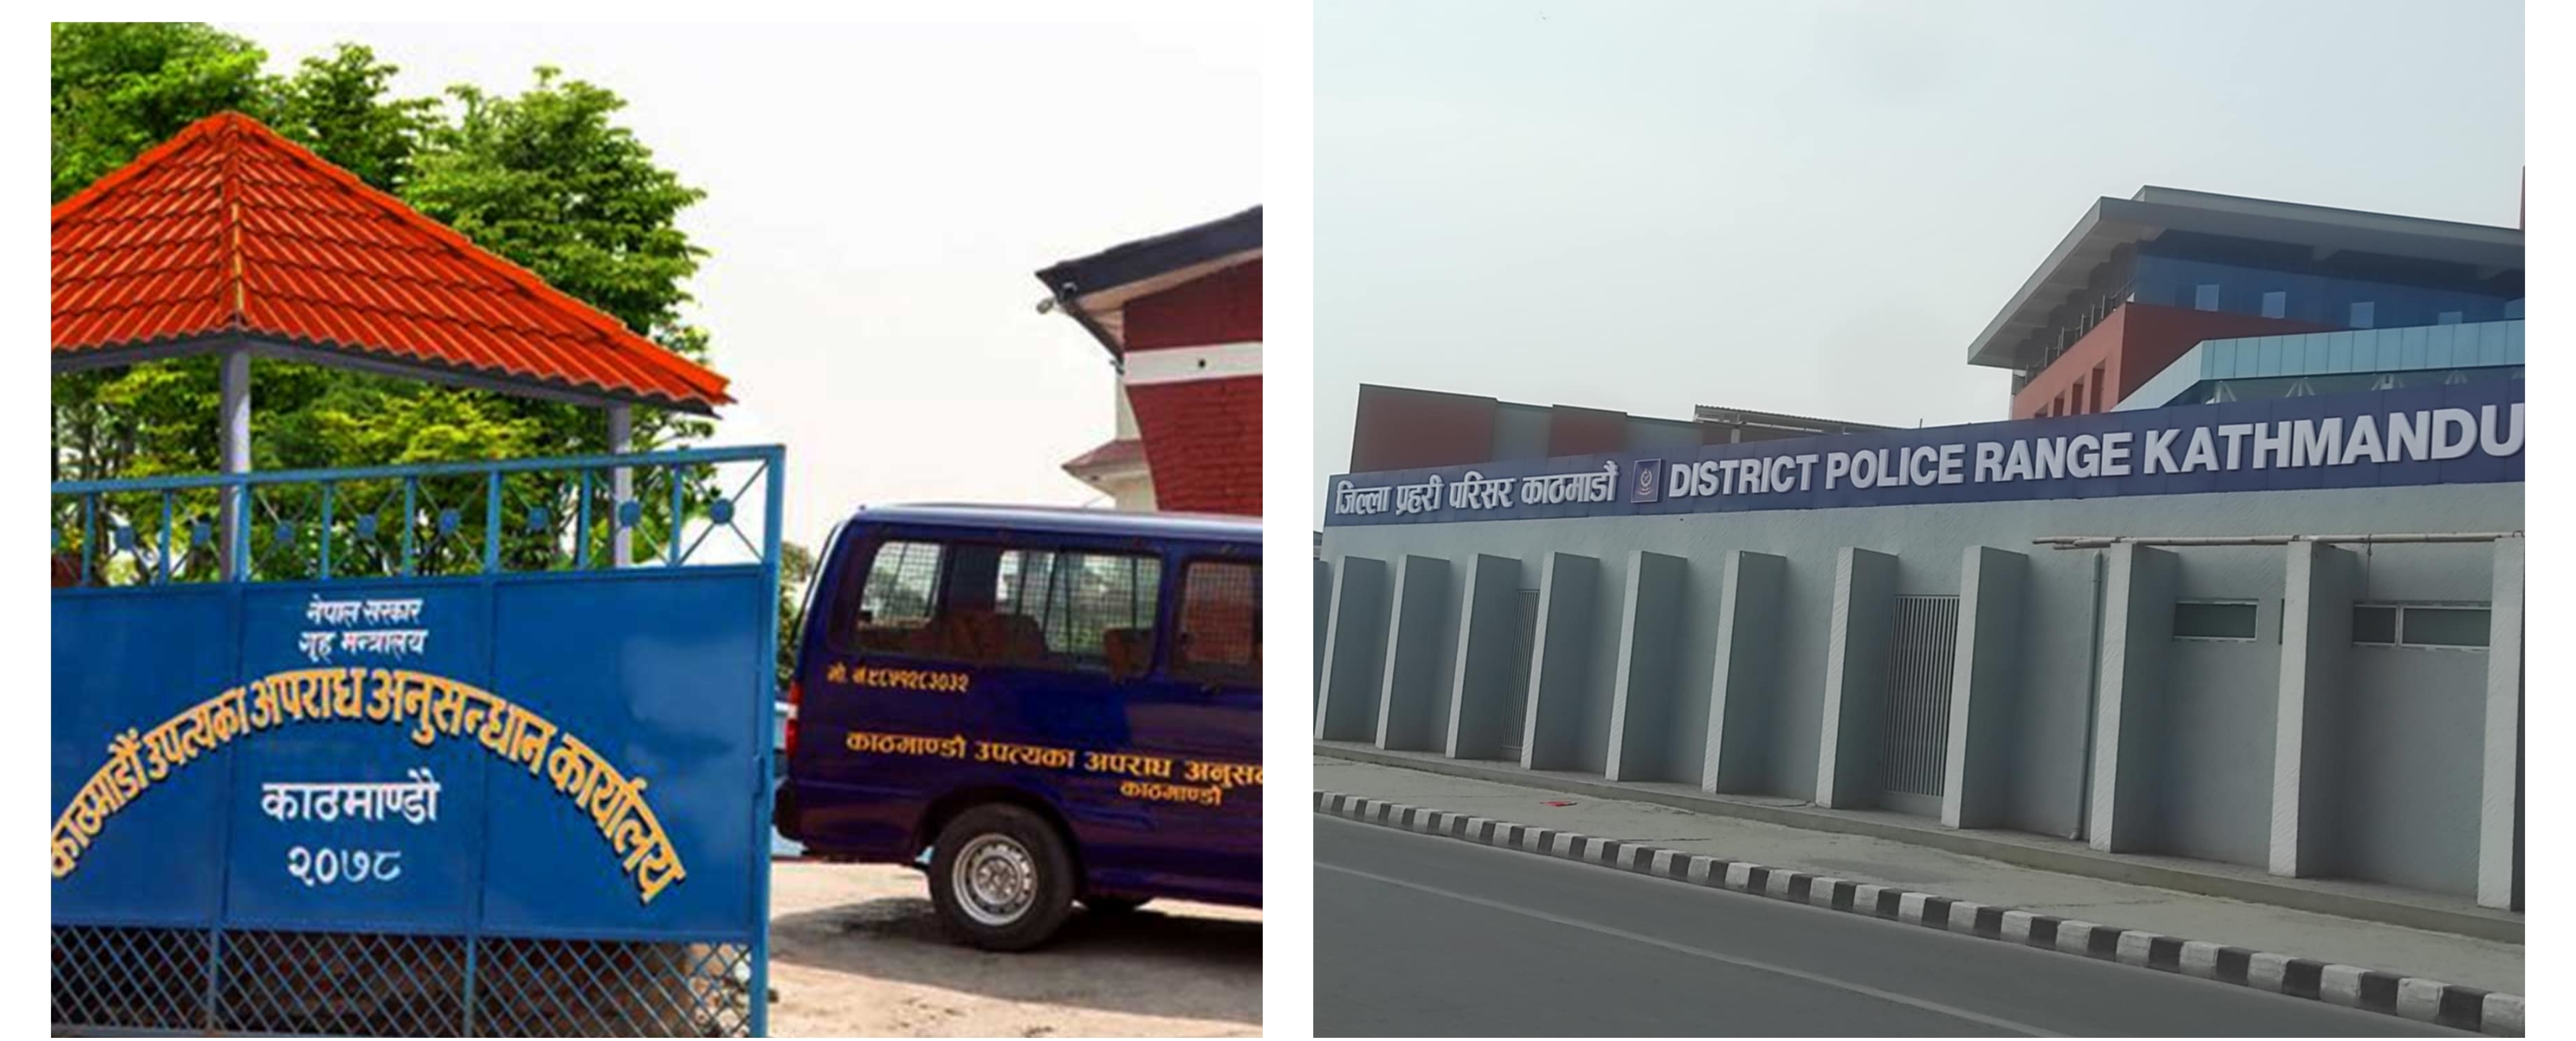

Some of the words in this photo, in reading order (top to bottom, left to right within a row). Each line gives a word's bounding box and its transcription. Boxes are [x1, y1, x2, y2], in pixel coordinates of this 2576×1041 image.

[1668, 454, 1819, 498] DISTRICT
[1825, 444, 1966, 490] POLICE
[1974, 432, 2133, 483] RANGE
[2143, 403, 2525, 475] KATHMANDU
[1335, 480, 1391, 515] जिल्ला
[1395, 475, 1443, 515] प्रहरी
[1449, 471, 1517, 509] परिसर
[306, 593, 362, 628] नेपाल
[363, 598, 424, 626] सरकार
[298, 631, 336, 664] गृह
[974, 741, 1075, 769] उपत्यका
[1084, 751, 1172, 776] अपराध
[142, 686, 250, 780] उपत्यका
[251, 668, 367, 730] अपराध
[366, 668, 558, 775] अनुसन्धान
[548, 726, 687, 903] कार्यालय
[261, 767, 441, 825] काठमाण्डौ
[287, 846, 401, 887] २०७८
